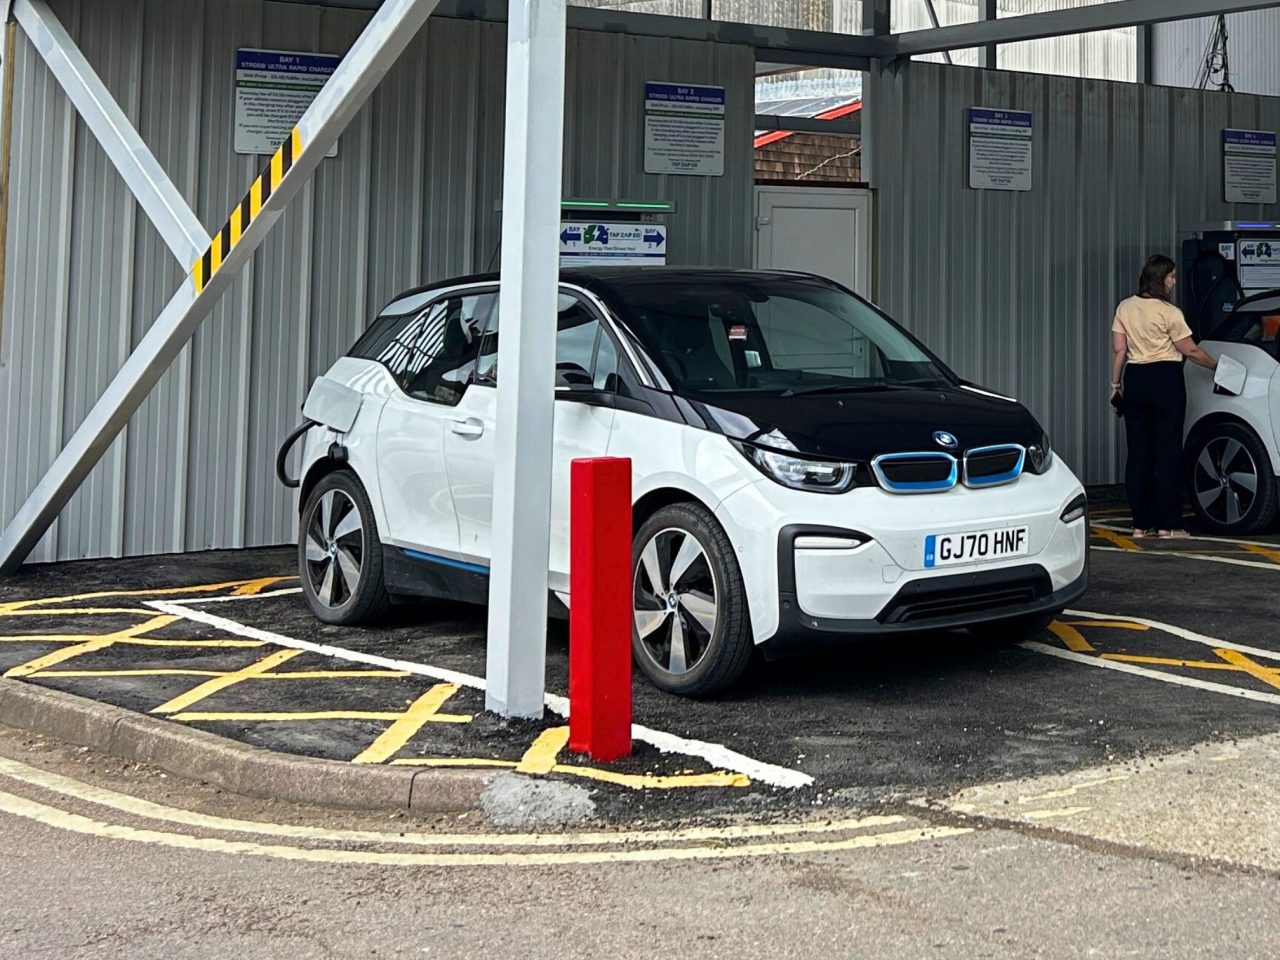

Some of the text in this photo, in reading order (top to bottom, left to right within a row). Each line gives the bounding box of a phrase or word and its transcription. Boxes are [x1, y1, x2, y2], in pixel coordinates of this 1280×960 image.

[280, 56, 294, 64] BAY
[268, 63, 288, 71] ULTRA
[940, 528, 1026, 560] GJ70 HNF
